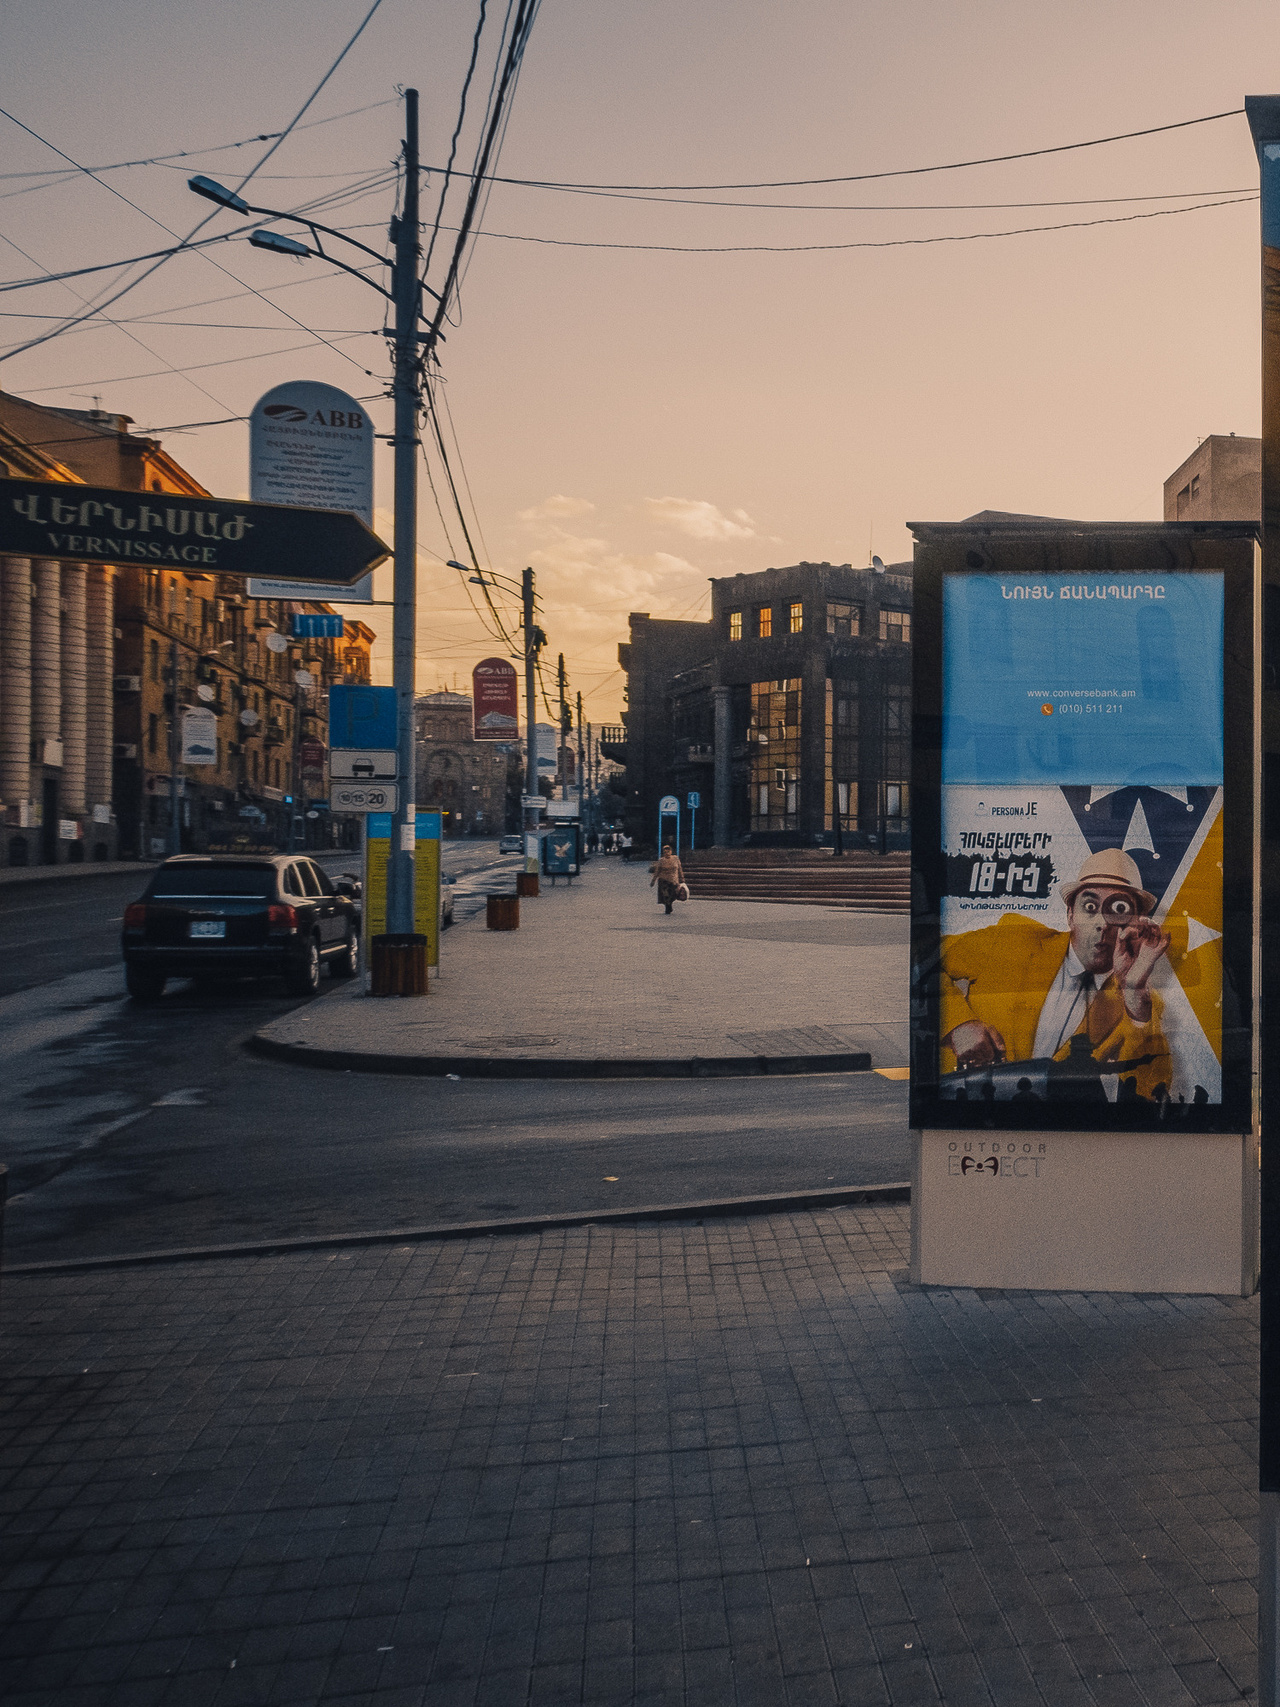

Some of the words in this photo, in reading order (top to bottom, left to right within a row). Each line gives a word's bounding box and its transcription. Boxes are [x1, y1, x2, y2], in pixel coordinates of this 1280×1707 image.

[310, 409, 363, 429] ABB
[13, 494, 254, 541] ՎԵՐՆԻՍԱԺ
[47, 532, 217, 563] VERNISSAGE
[1001, 585, 1055, 600] ՆՈՒՅՆ
[1059, 585, 1166, 600] ՃԱՆԱՊԱՐՀԸ
[1027, 688, 1136, 699] www.conversebank.am
[1059, 703, 1083, 715] (010)
[1085, 703, 1103, 714] 511
[1106, 703, 1123, 713] 211
[368, 793, 384, 804] 20
[948, 1142, 1046, 1153] OUTDOOR
